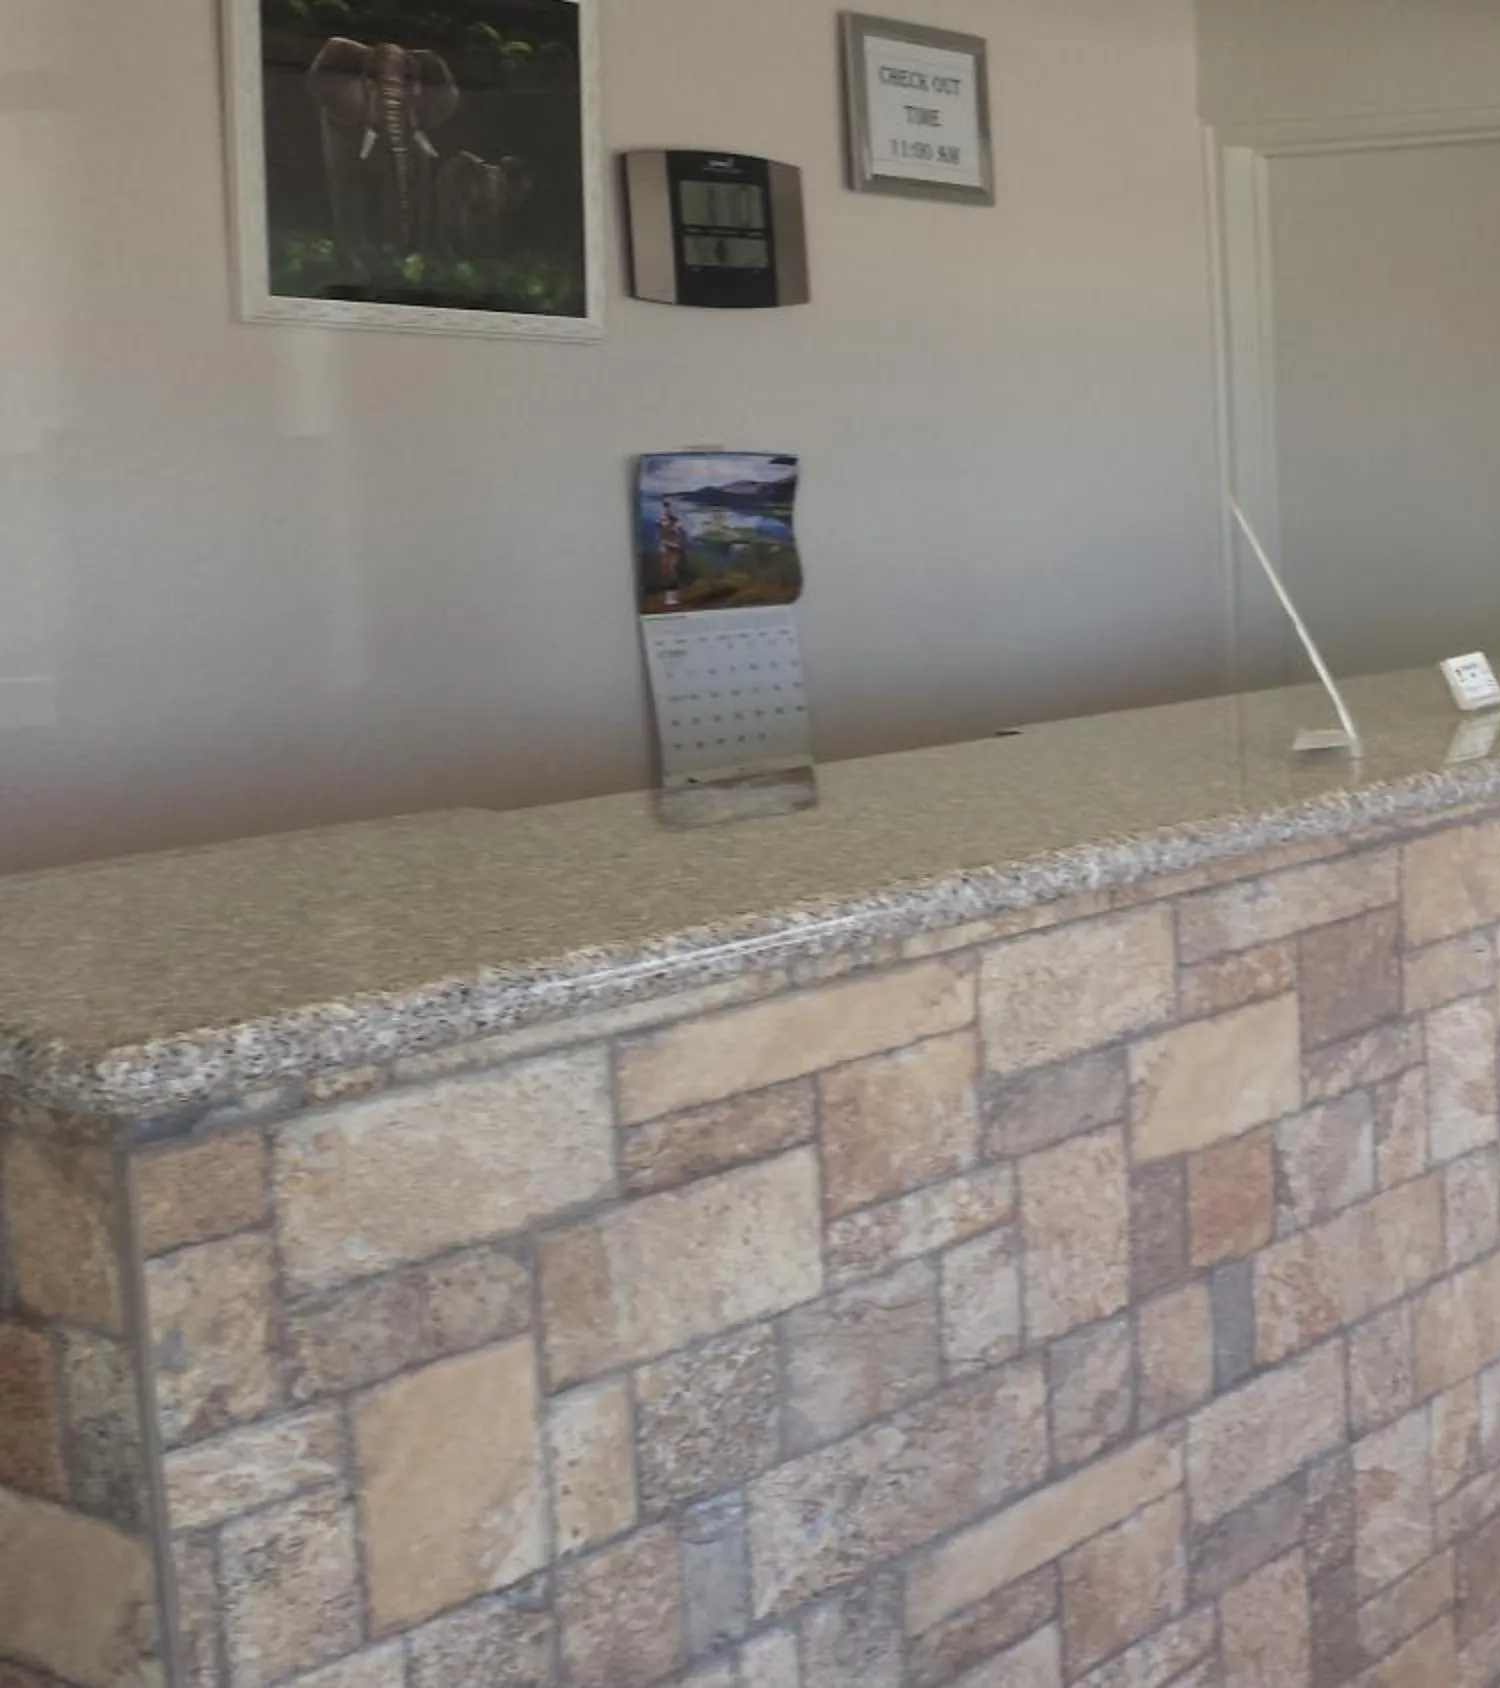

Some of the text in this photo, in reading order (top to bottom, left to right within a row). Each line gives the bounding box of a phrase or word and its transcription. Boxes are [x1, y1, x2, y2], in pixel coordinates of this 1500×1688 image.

[878, 65, 961, 96] CHECK OUT
[903, 105, 942, 127] TIME
